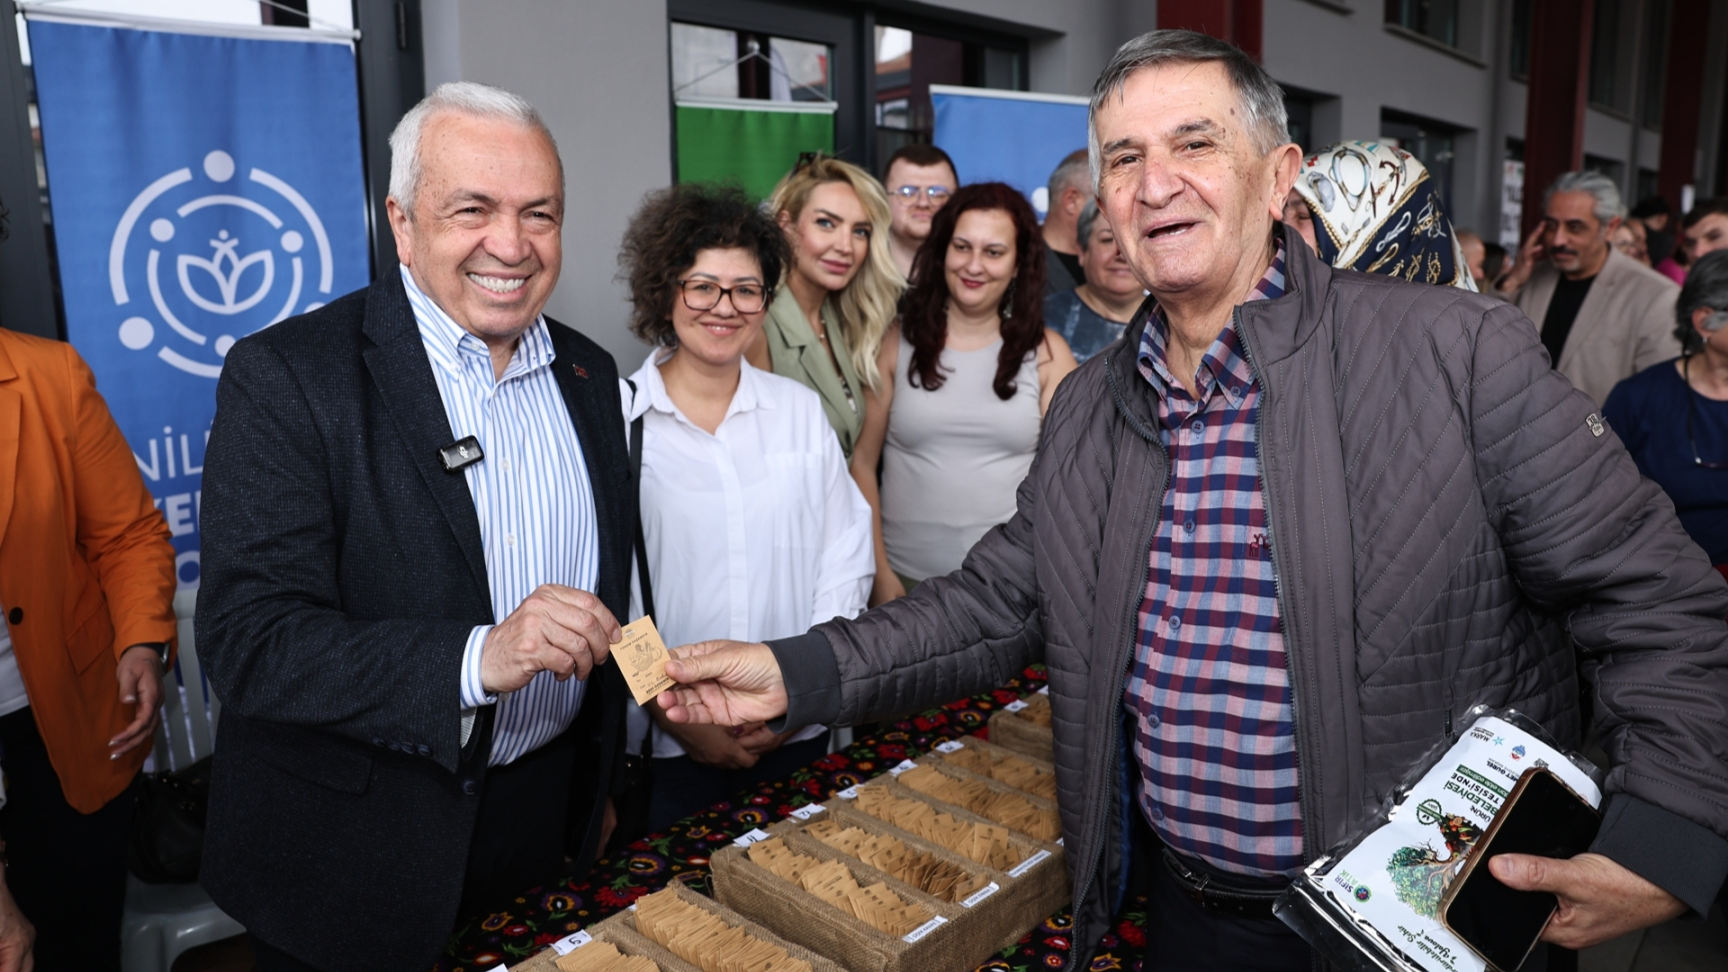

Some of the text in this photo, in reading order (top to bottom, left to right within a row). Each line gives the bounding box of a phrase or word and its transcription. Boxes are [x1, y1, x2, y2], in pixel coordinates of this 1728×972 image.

[1443, 780, 1499, 816] BELEDİYESİ
[1451, 772, 1500, 804] TESİSİ'NDE
[1335, 875, 1354, 893] SIFIR
[1339, 869, 1358, 886] ATIK
[1424, 935, 1450, 959] Yalova
